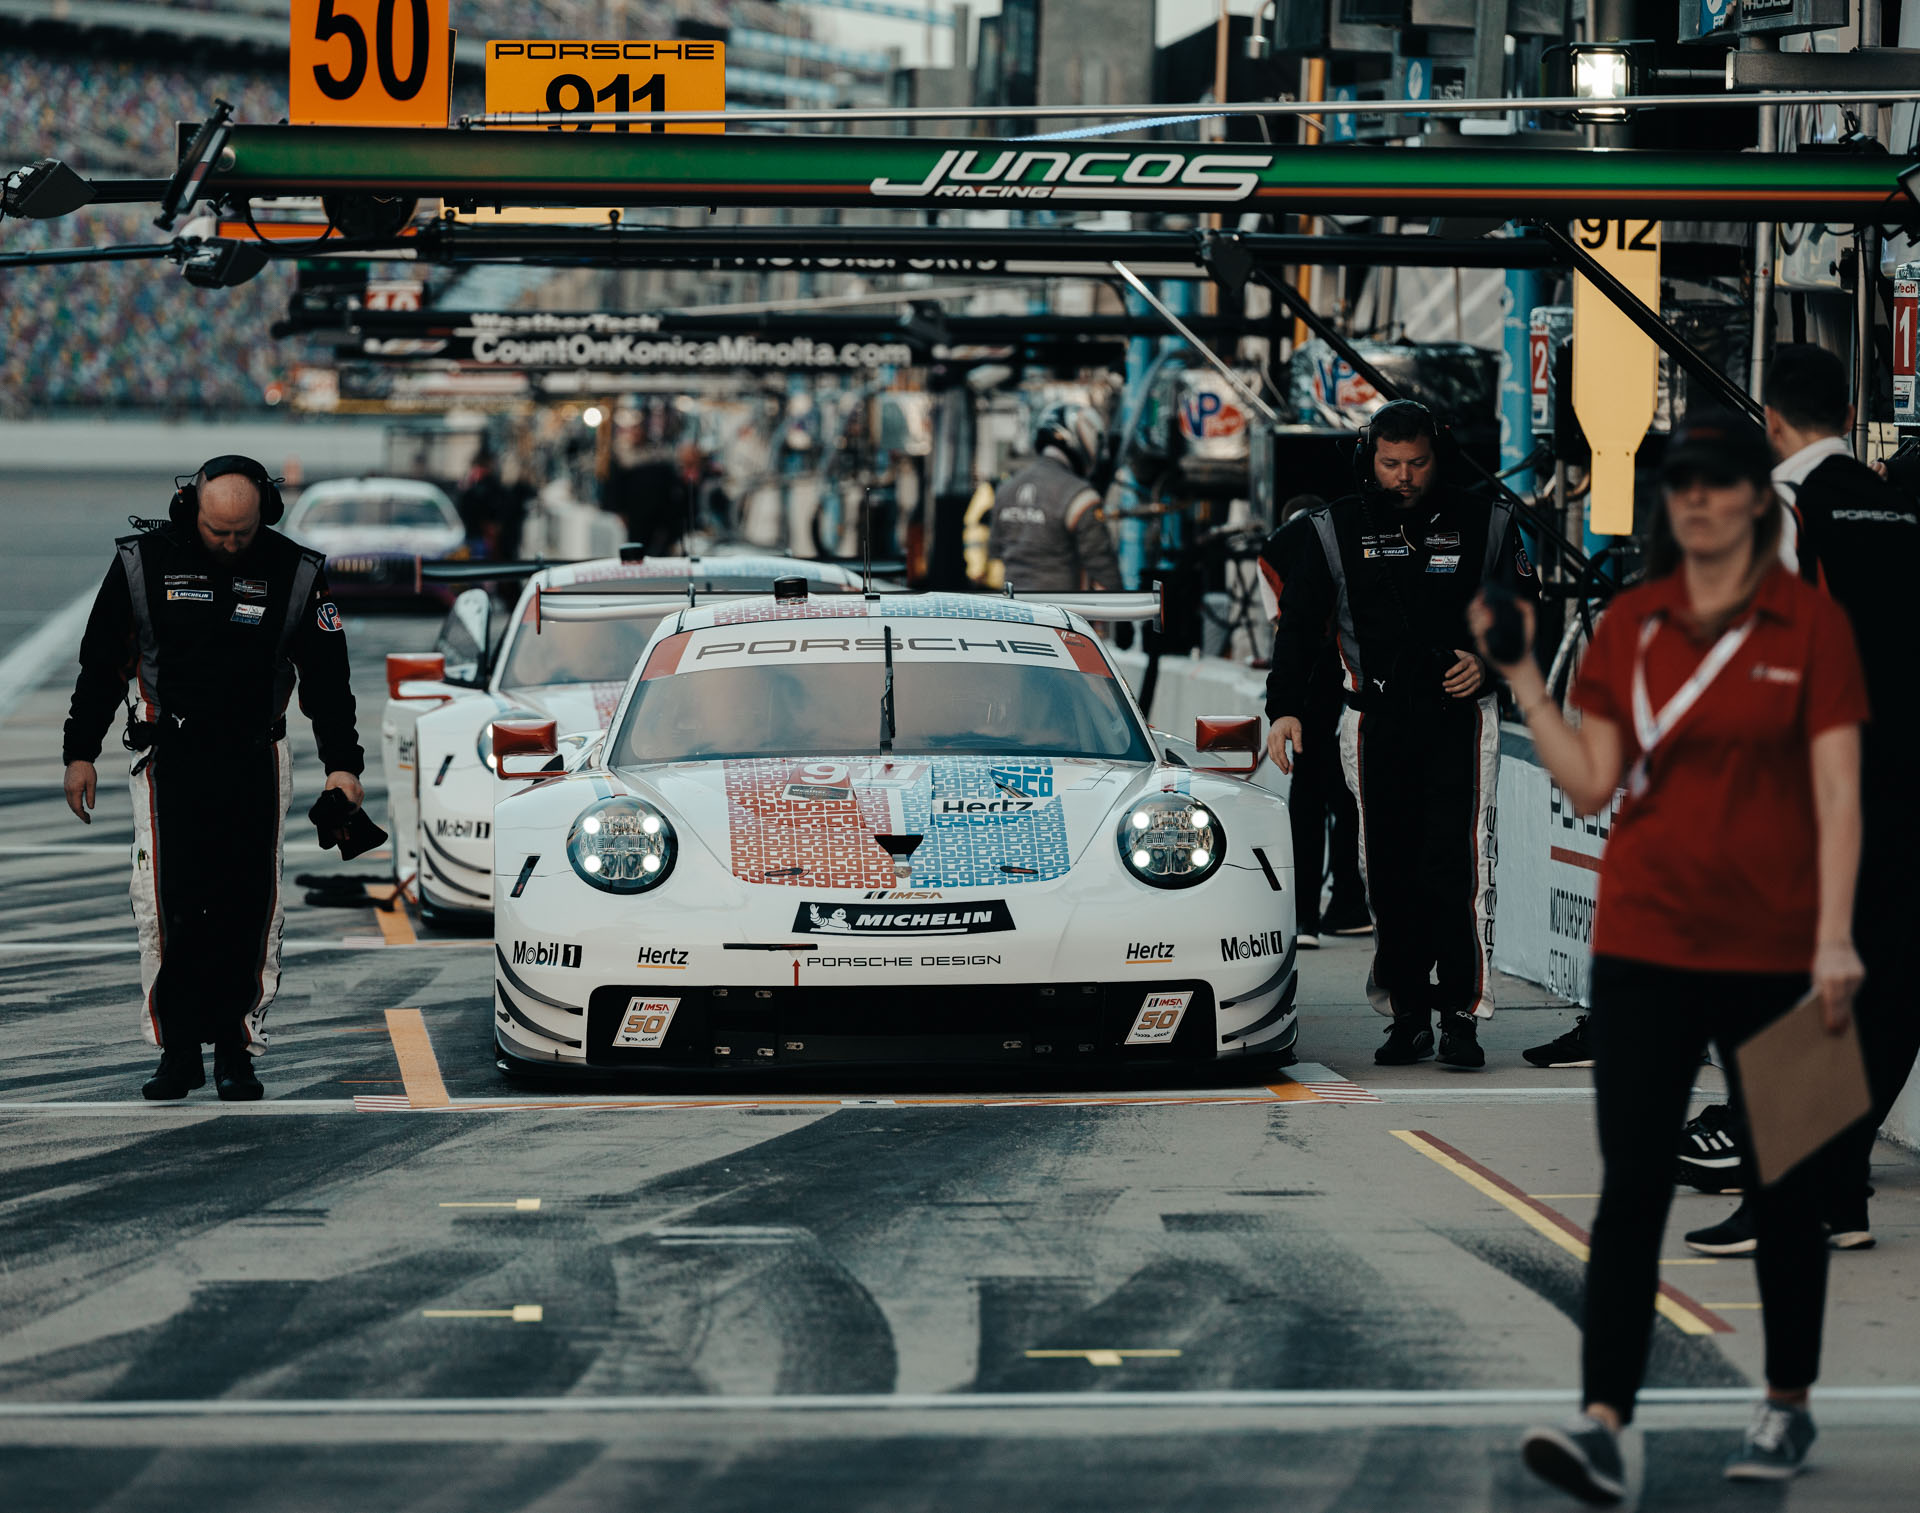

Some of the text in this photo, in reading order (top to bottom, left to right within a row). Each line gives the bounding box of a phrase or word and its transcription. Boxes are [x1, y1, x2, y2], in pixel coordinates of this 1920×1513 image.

[312, 0, 430, 101] 50
[495, 43, 715, 60] PORSCHE
[545, 73, 665, 132] 911
[934, 185, 1053, 199] RACING
[1579, 217, 1657, 252] 912
[471, 333, 911, 365] CountOnKonicaMinolta.com
[180, 591, 210, 599] MICHELIN
[696, 637, 1059, 660] PORSCHE
[942, 800, 1034, 814] Hertz
[436, 819, 472, 839] Mobil
[887, 891, 943, 900] IMSA
[855, 910, 993, 928] MICHELIN
[512, 940, 560, 967] Mobil
[636, 946, 688, 965] Hertz
[1126, 942, 1175, 960] Hertz
[1220, 931, 1270, 962] Mobil
[807, 954, 1001, 967] PORSCHE DESIGN
[643, 1003, 670, 1011] IMSA
[1158, 998, 1183, 1006] IMSA
[624, 1014, 667, 1034] 50
[1137, 1010, 1180, 1031] 50
